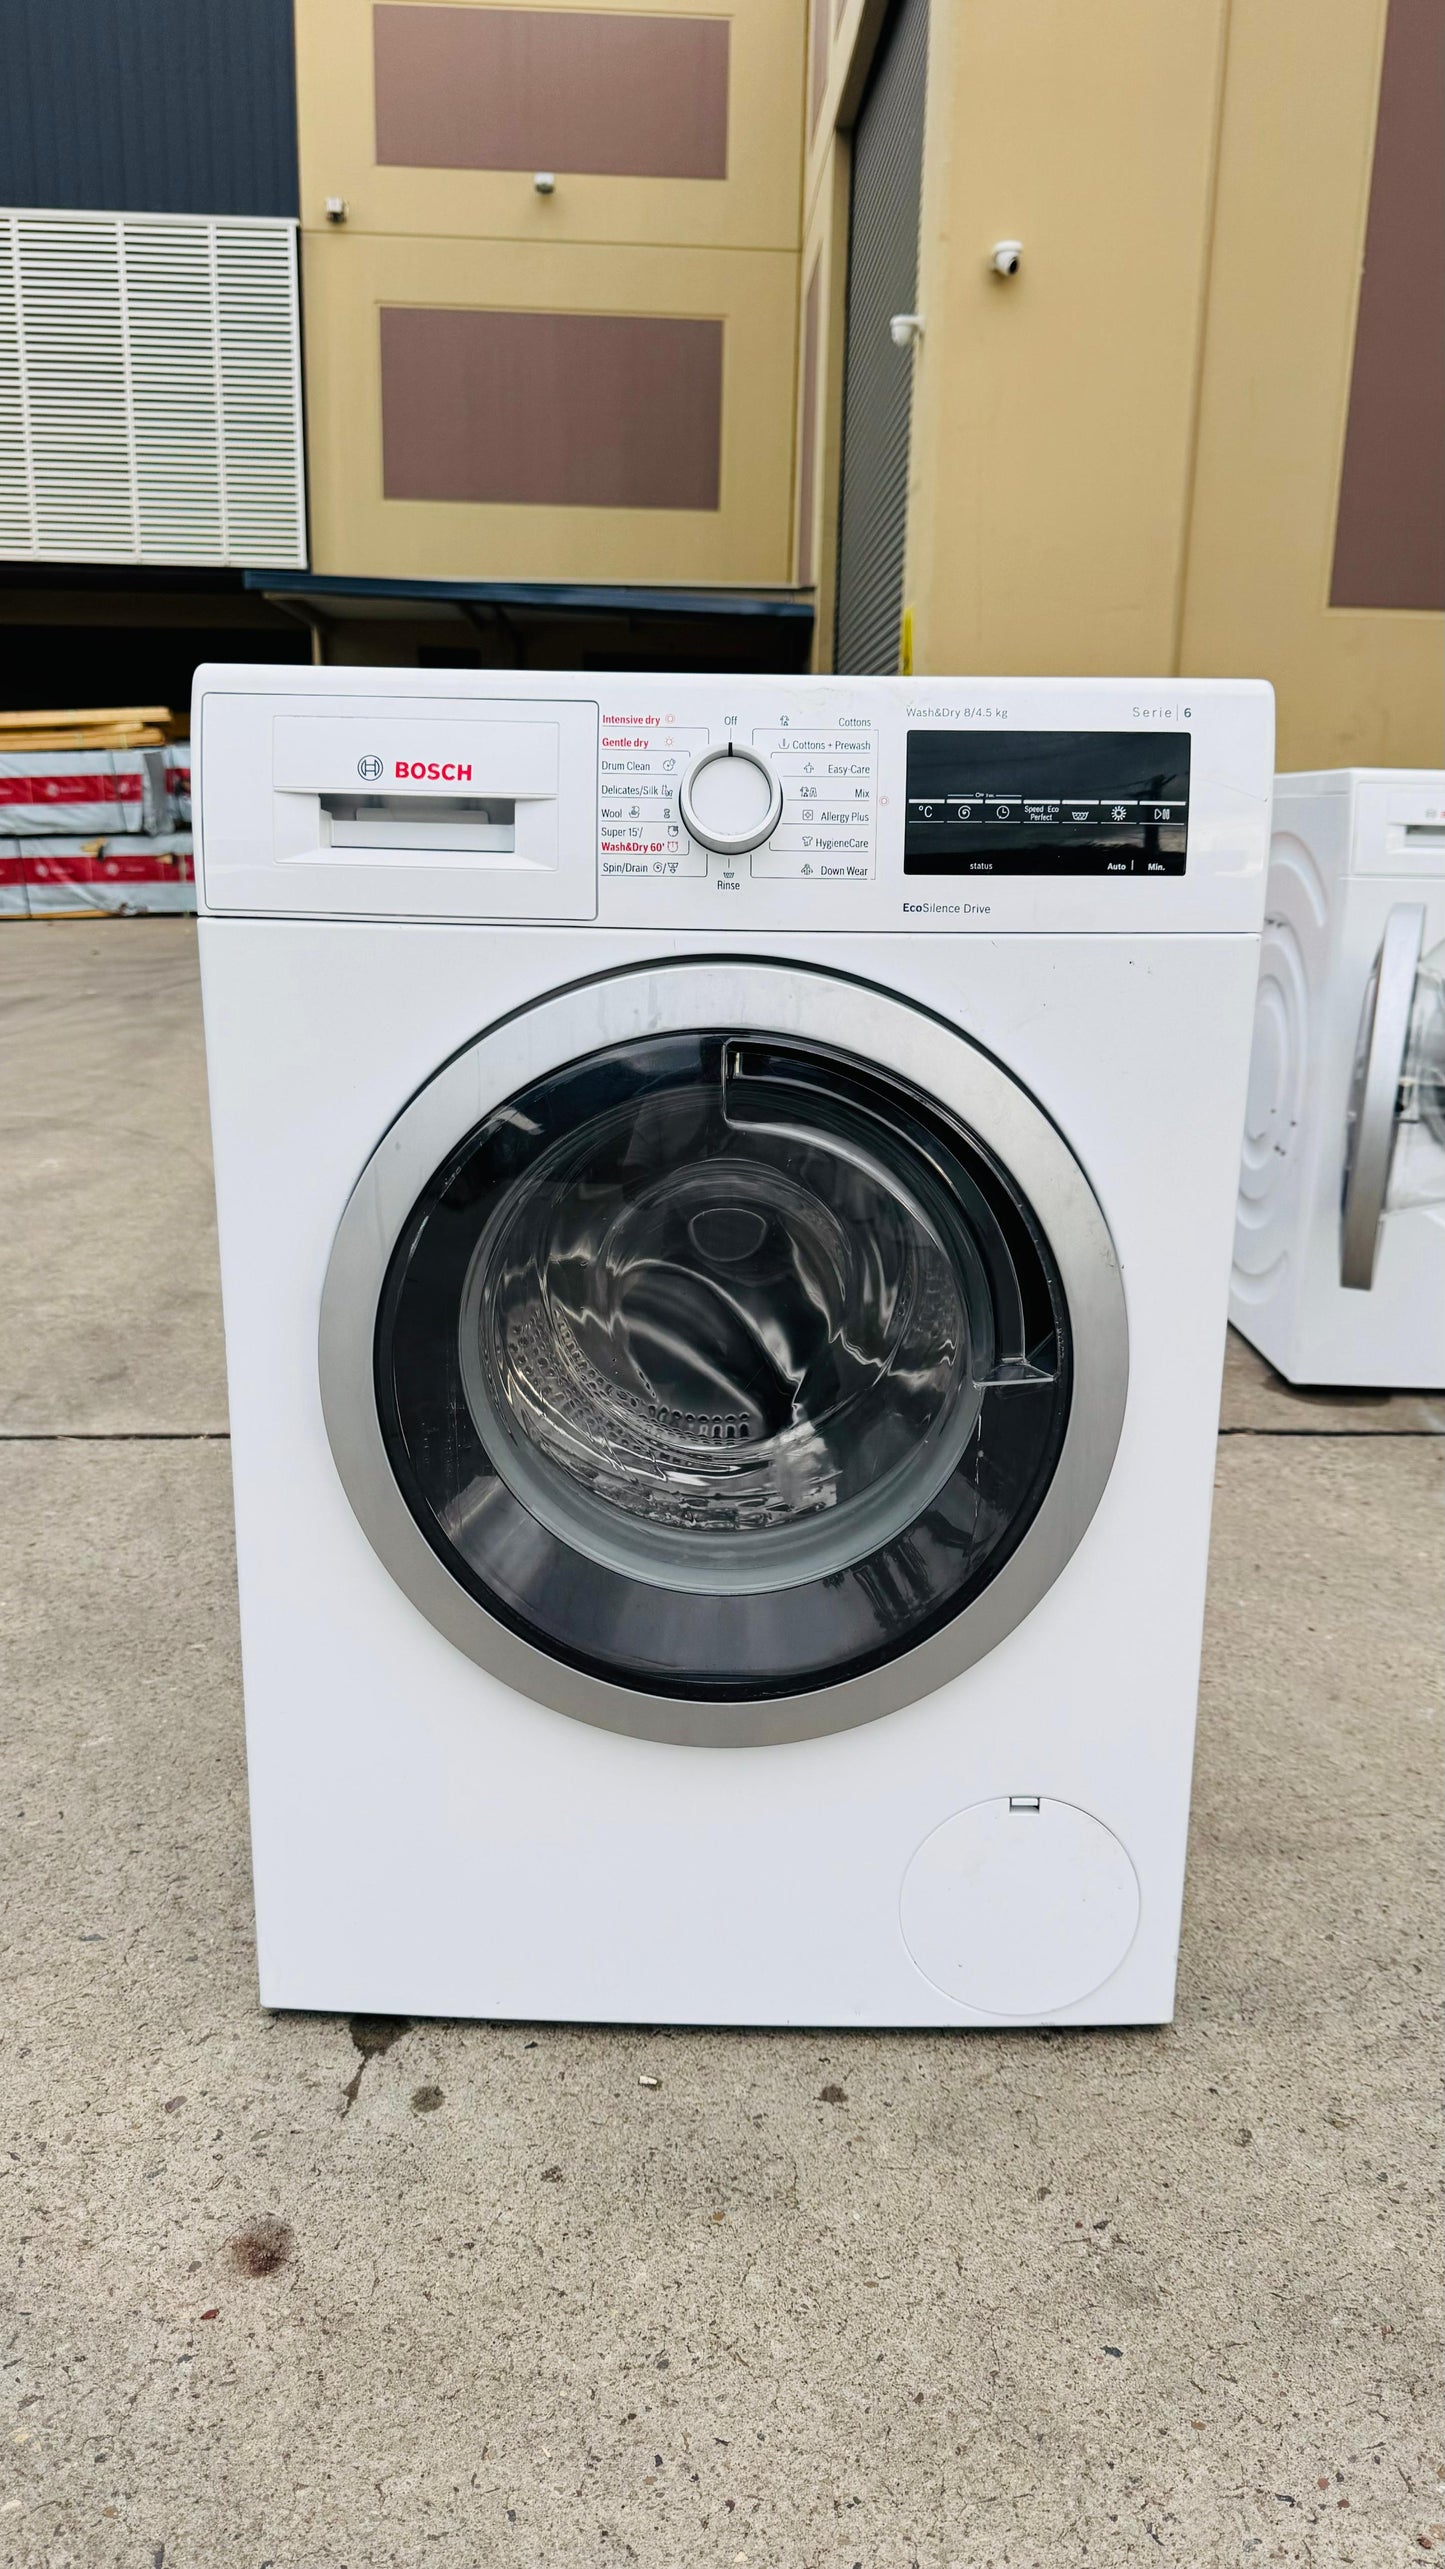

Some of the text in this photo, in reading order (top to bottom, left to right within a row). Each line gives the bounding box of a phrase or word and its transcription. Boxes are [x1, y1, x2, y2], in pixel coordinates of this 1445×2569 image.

[906, 708, 1008, 719] Wash&Dry 8/4.5 kg
[1132, 707, 1192, 718] Serie 6
[602, 715, 660, 726] Intensive dry
[724, 716, 738, 725] Off
[838, 718, 871, 727] Cottons
[602, 738, 648, 749] Gentle dry
[792, 740, 825, 750] Cottons
[835, 740, 871, 750] Prewash
[602, 761, 650, 770] Drum Clean
[828, 765, 870, 775] Easy-Care
[395, 761, 472, 781] BOSCH
[602, 785, 658, 796] Delicates/Silk
[855, 789, 870, 798] Mix
[601, 809, 622, 818] Wool
[1024, 806, 1044, 814] Speed
[821, 812, 869, 823] Allergy Plus
[1030, 813, 1052, 821] Perfect
[601, 828, 625, 838] Super
[602, 842, 648, 853] Wash&Dry
[816, 839, 869, 849] HygieneCare
[603, 862, 648, 873] Spin/Drain
[820, 866, 868, 876] Down Wear
[970, 862, 993, 870] status
[1107, 862, 1126, 870] Auto
[717, 881, 740, 890] Rinse
[903, 903, 991, 914] EcoSilence Drive
